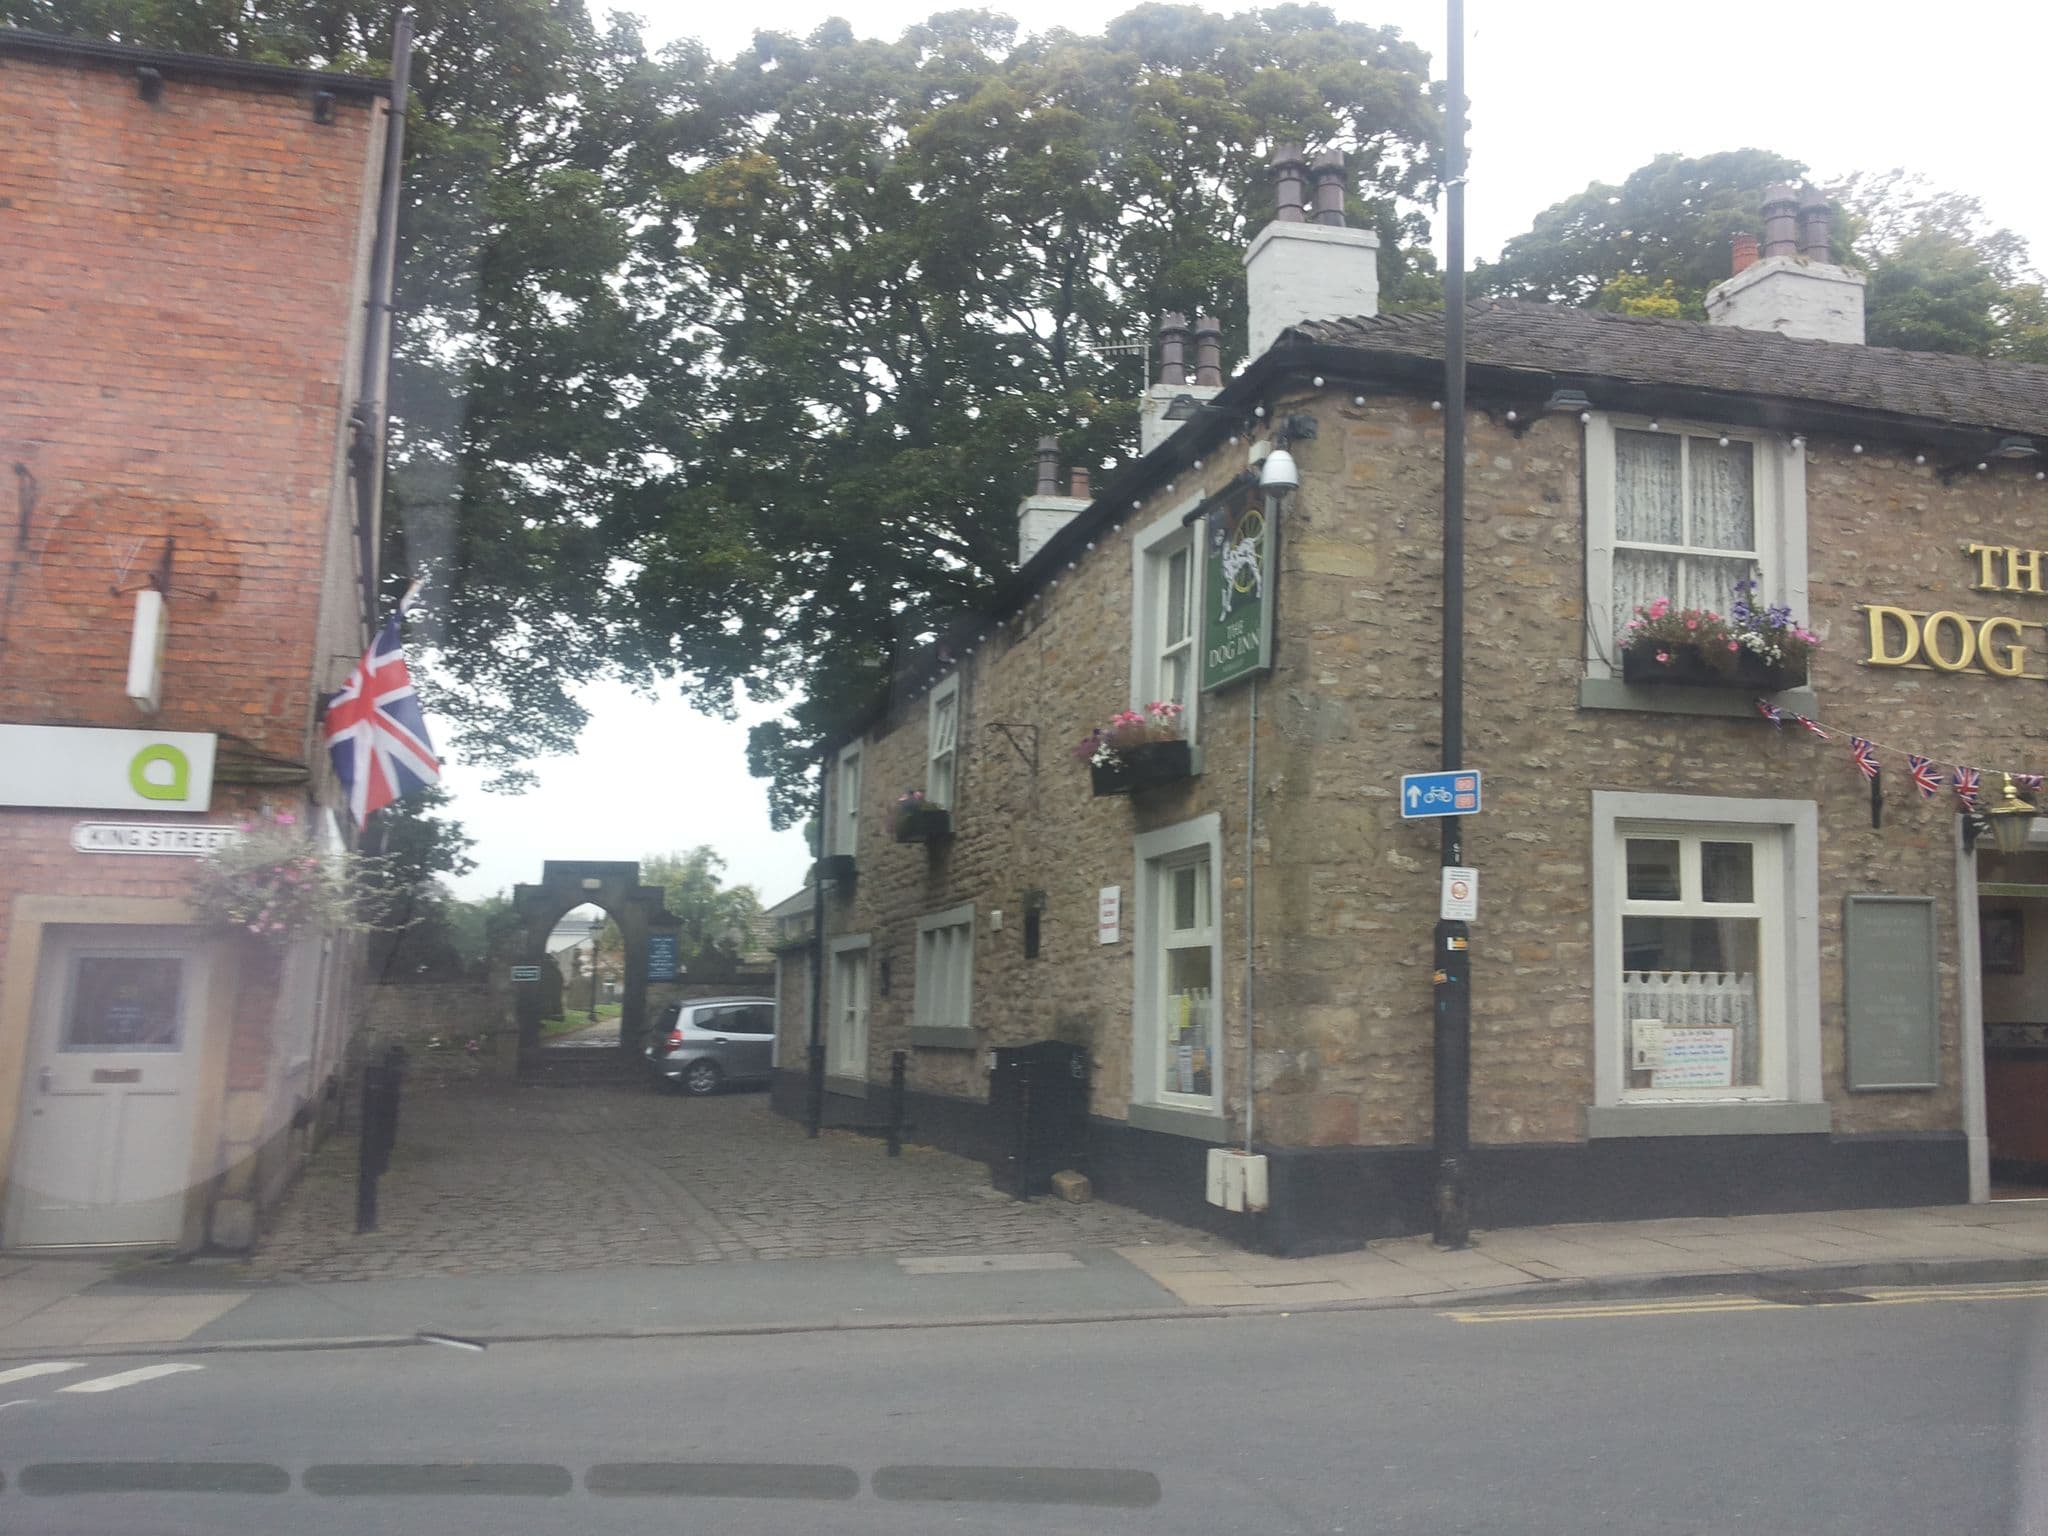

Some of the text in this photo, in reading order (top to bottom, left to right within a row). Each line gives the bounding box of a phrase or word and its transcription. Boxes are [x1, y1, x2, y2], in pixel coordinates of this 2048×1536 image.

[1969, 544, 2048, 592] TH
[1209, 641, 1235, 667] DOG
[1237, 630, 1260, 655] INN
[1227, 620, 1244, 640] THE
[1864, 604, 2027, 677] DOG
[90, 829, 140, 846] KING
